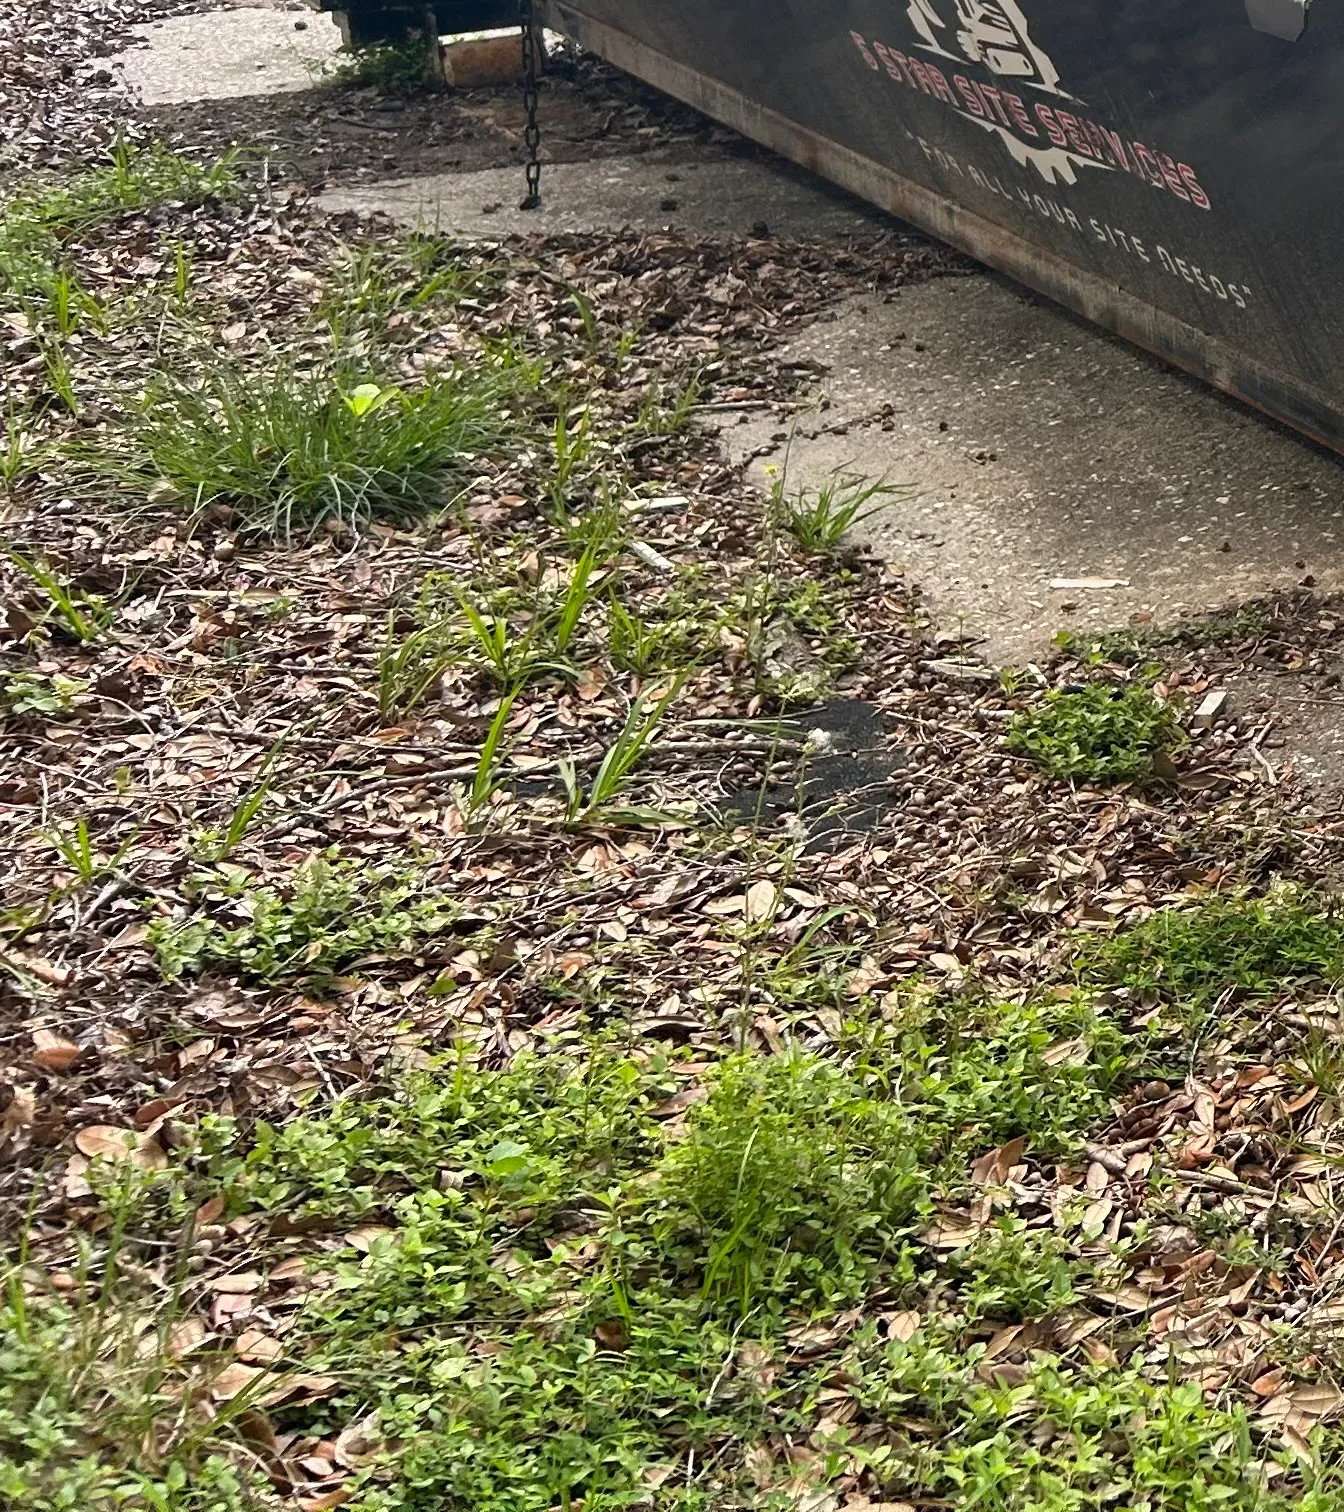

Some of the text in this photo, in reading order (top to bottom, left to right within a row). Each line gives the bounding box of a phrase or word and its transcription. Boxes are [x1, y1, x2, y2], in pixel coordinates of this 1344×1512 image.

[952, 74, 1040, 138] SITE
[1034, 102, 1213, 212] SERVICES
[1016, 186, 1083, 233] YOUR
[1089, 216, 1151, 264] SITE
